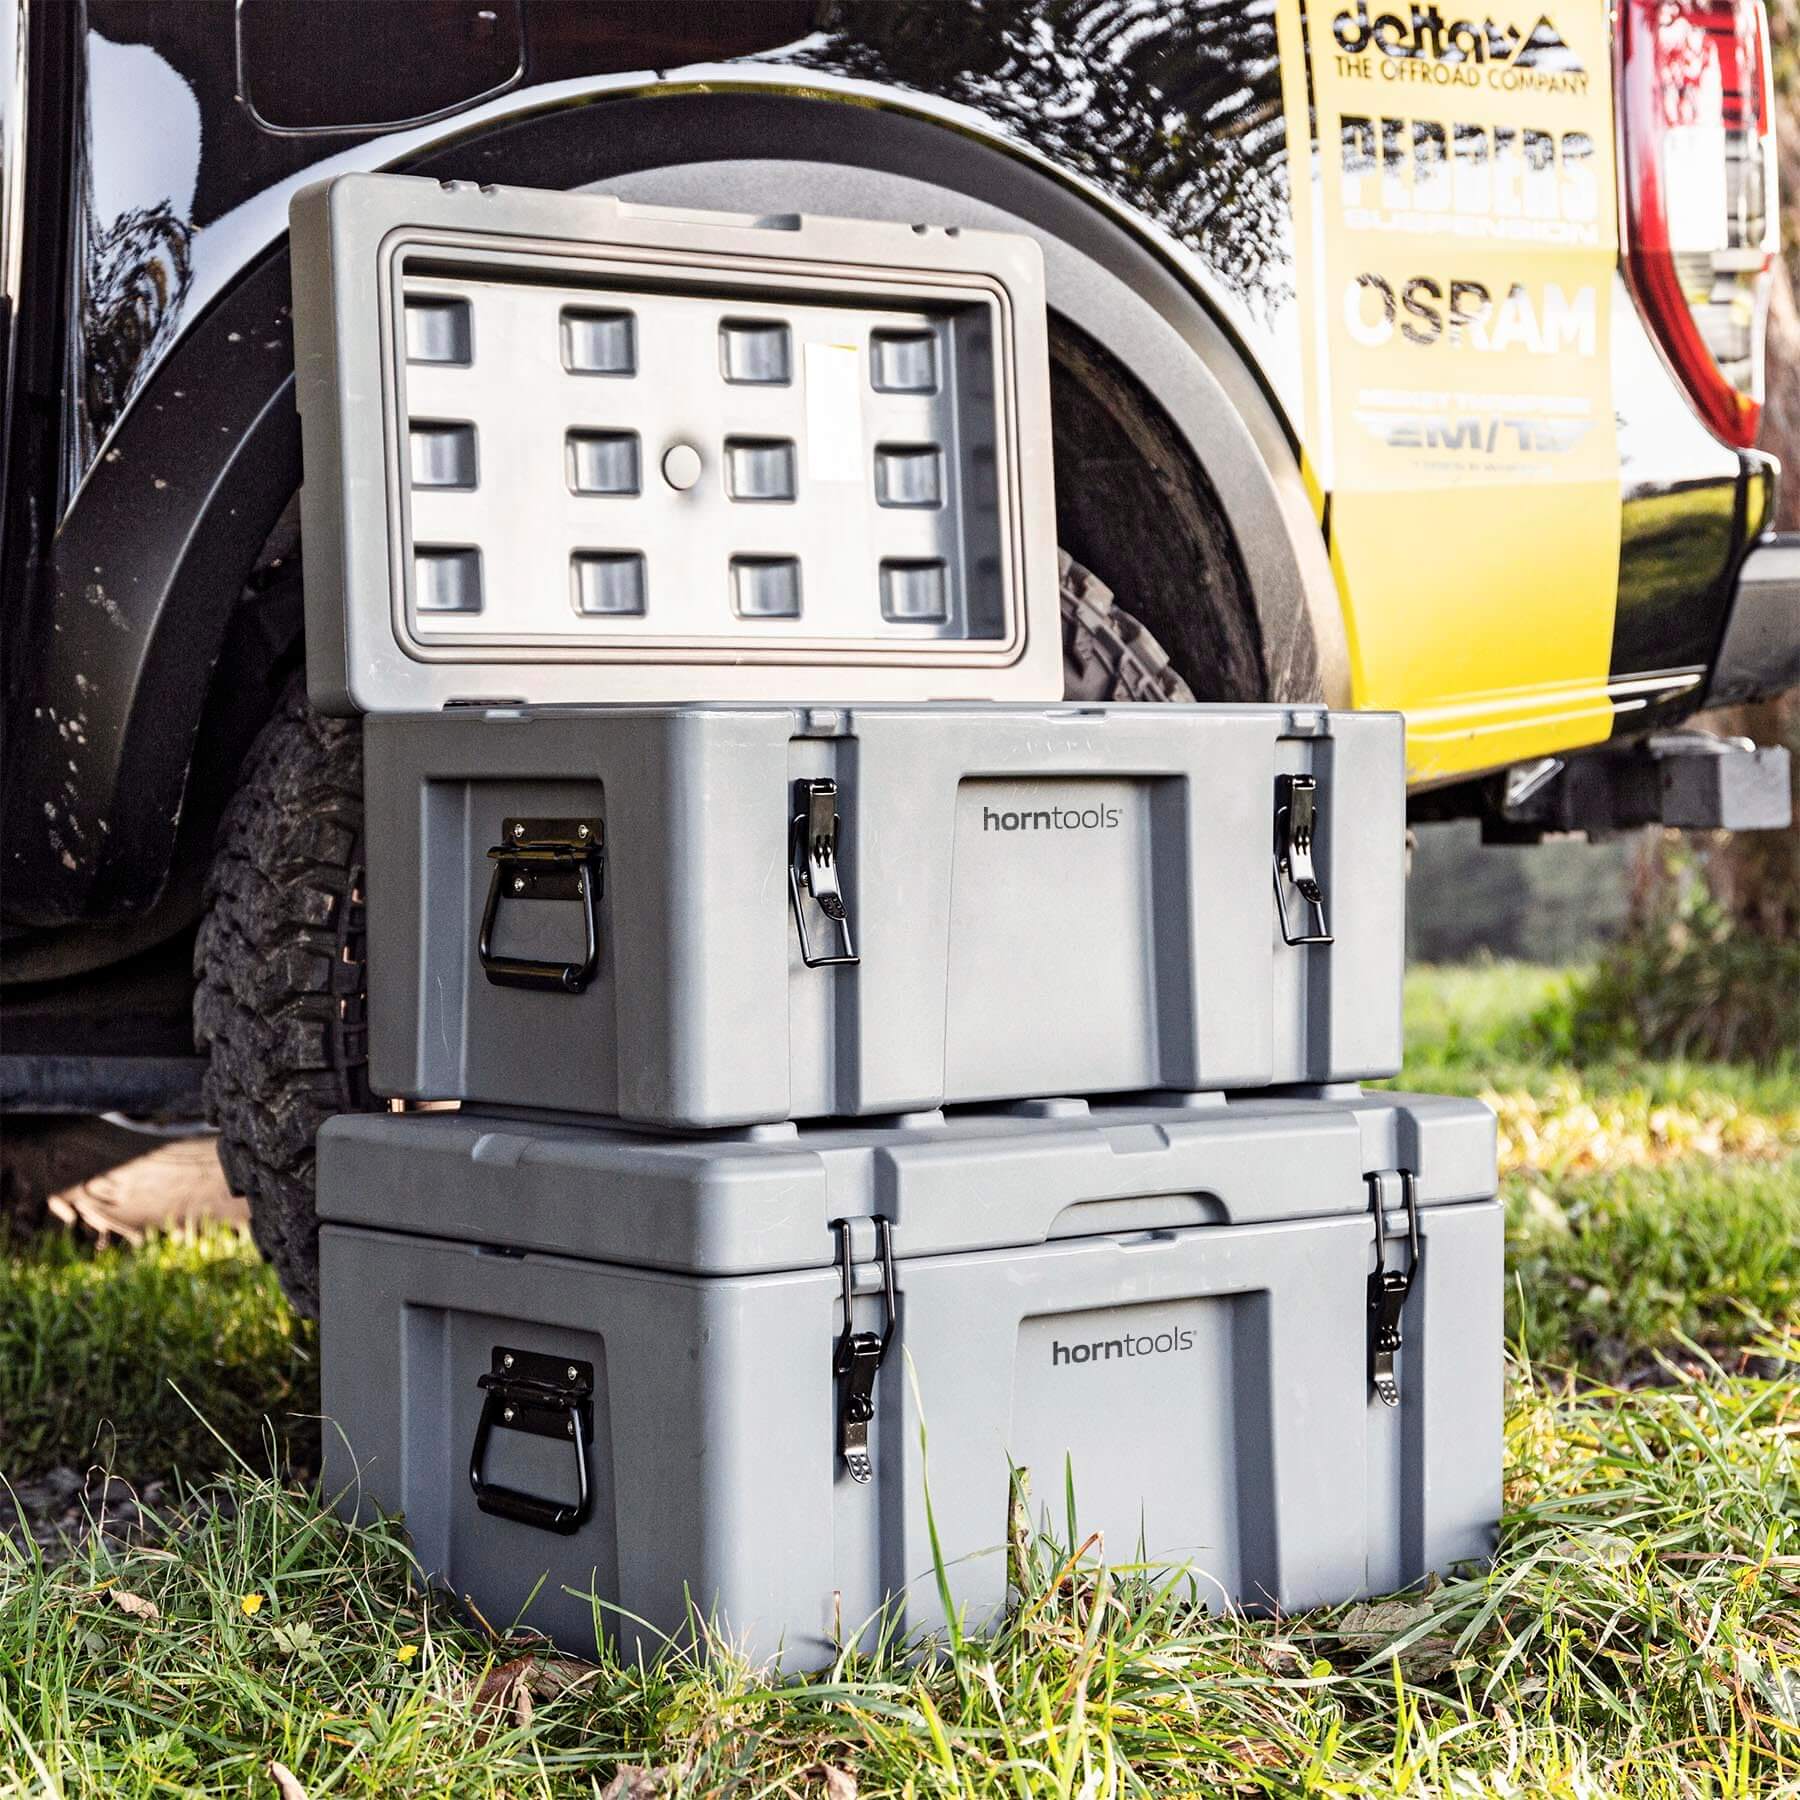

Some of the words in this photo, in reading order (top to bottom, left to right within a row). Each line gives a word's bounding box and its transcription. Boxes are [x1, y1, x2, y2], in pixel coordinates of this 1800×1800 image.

[1335, 55, 1372, 80] THE
[1380, 60, 1480, 88] OFFROAD
[1487, 67, 1590, 96] COMPANY
[1343, 271, 1597, 357] OSRAM
[983, 802, 1120, 831] horntools
[1052, 1325, 1194, 1366] horntools
